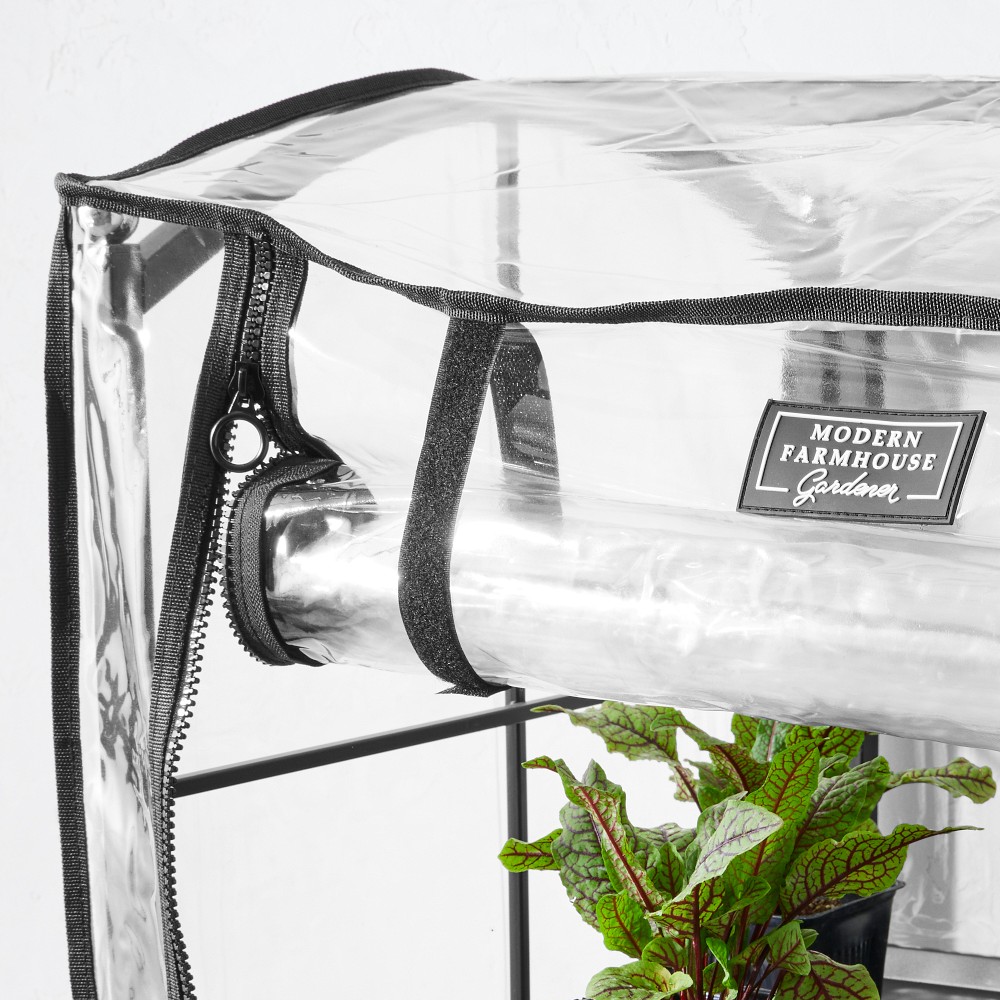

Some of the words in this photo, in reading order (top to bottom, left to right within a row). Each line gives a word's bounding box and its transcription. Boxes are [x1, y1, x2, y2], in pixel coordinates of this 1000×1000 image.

[810, 423, 922, 448] MODERN
[779, 444, 937, 471] FARMHOUSE
[792, 468, 901, 507] Gardener
